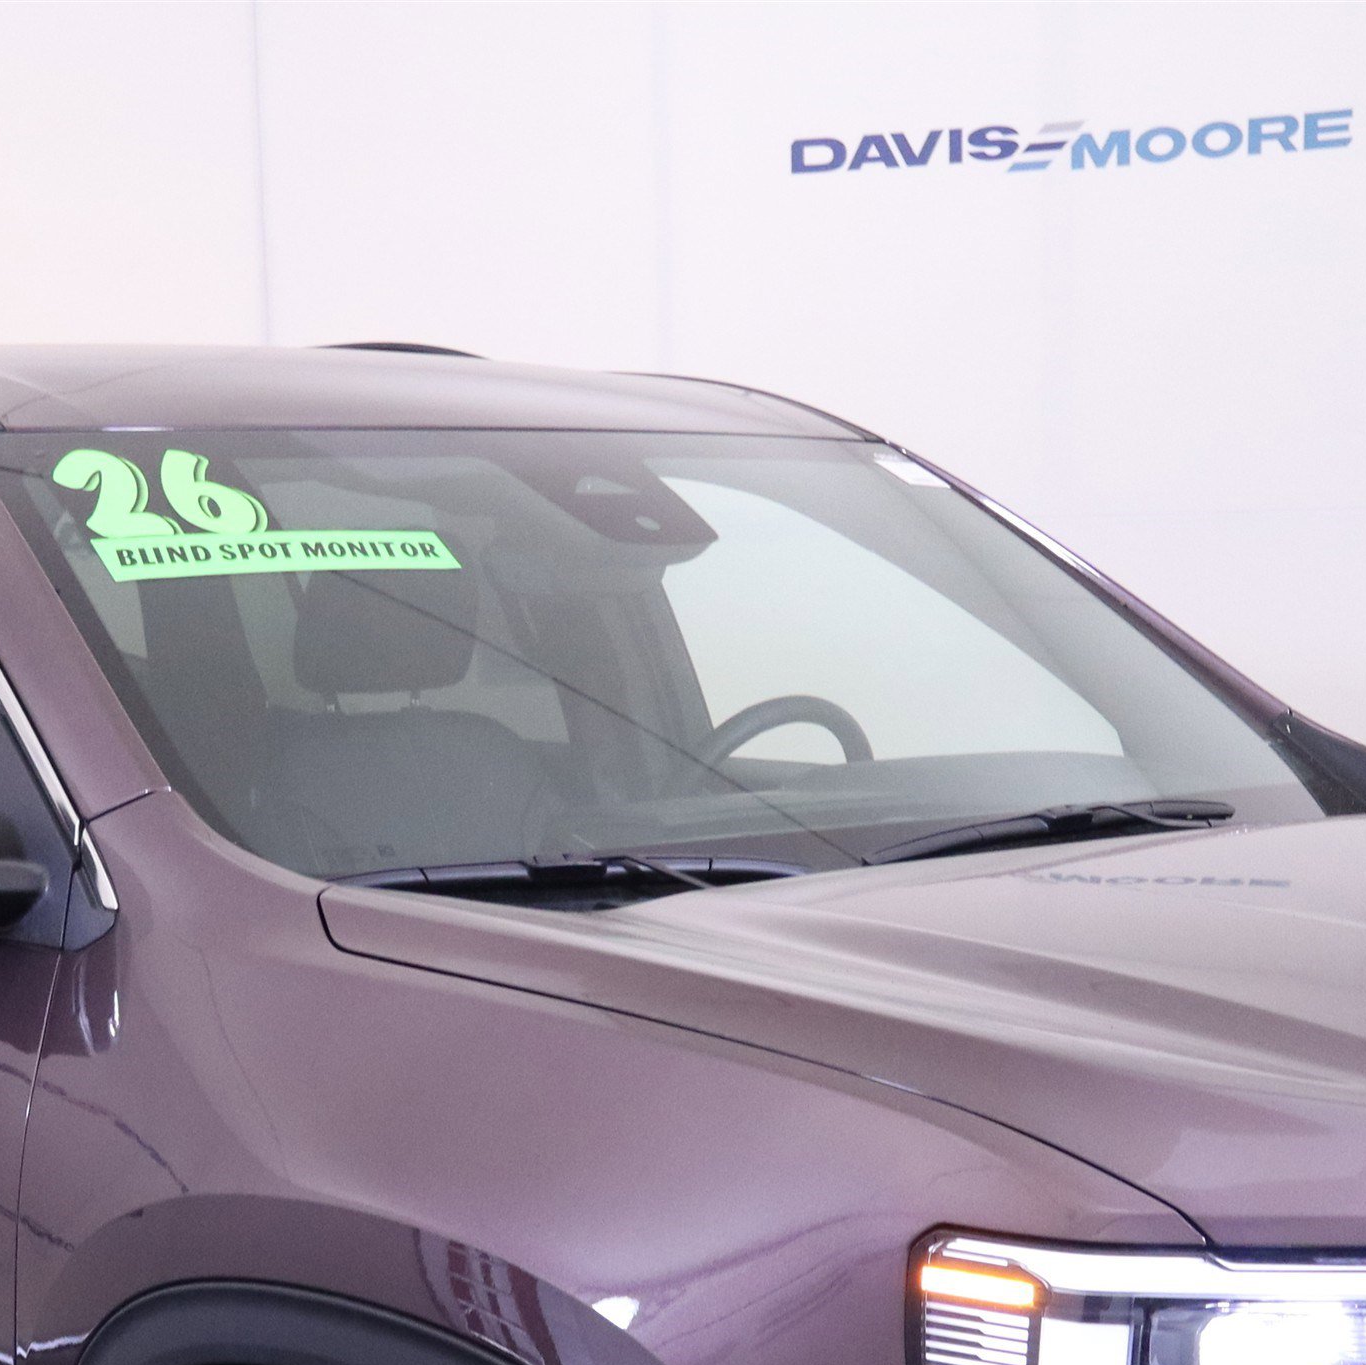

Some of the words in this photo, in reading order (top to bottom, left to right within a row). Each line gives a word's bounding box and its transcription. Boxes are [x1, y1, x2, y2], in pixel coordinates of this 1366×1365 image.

[791, 125, 1021, 173] DAVIS
[1070, 109, 1353, 169] MOORE
[53, 449, 268, 538] 26
[116, 545, 212, 567] BLIND
[219, 542, 293, 561] SPOT
[303, 541, 440, 559] MONITOR
